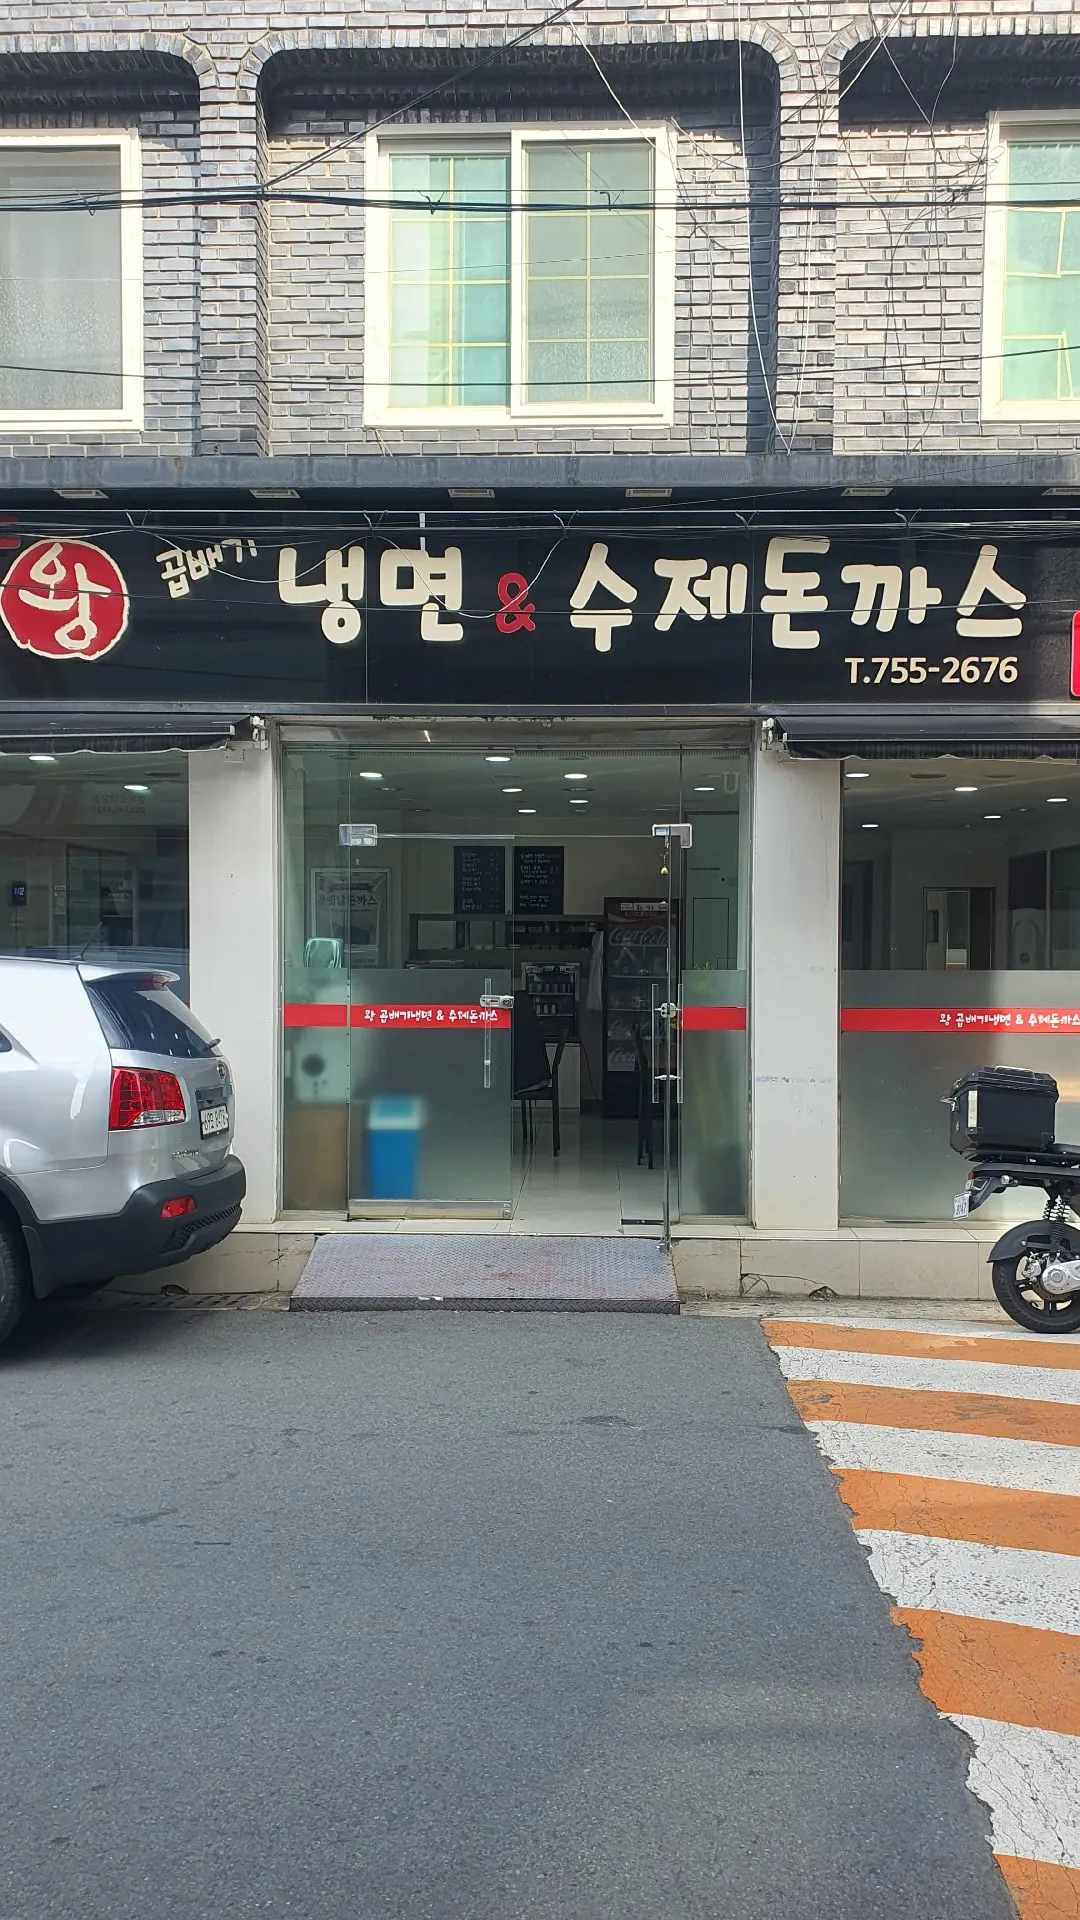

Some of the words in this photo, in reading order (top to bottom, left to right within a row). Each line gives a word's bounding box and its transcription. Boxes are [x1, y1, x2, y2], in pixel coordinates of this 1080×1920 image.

[18, 542, 112, 651] 왕
[156, 538, 258, 599] 곱배기
[278, 545, 464, 644] 냉면
[496, 572, 535, 633] &
[844, 656, 1019, 685] T.755-2676
[364, 1010, 376, 1022] 왕
[380, 1009, 432, 1024] 곱배기냉면
[436, 1010, 445, 1022] &
[449, 1009, 498, 1024] 수제돈까스
[939, 1013, 952, 1026] 왕
[955, 1012, 1012, 1028] 곱배기냉면
[1015, 1014, 1024, 1025] &
